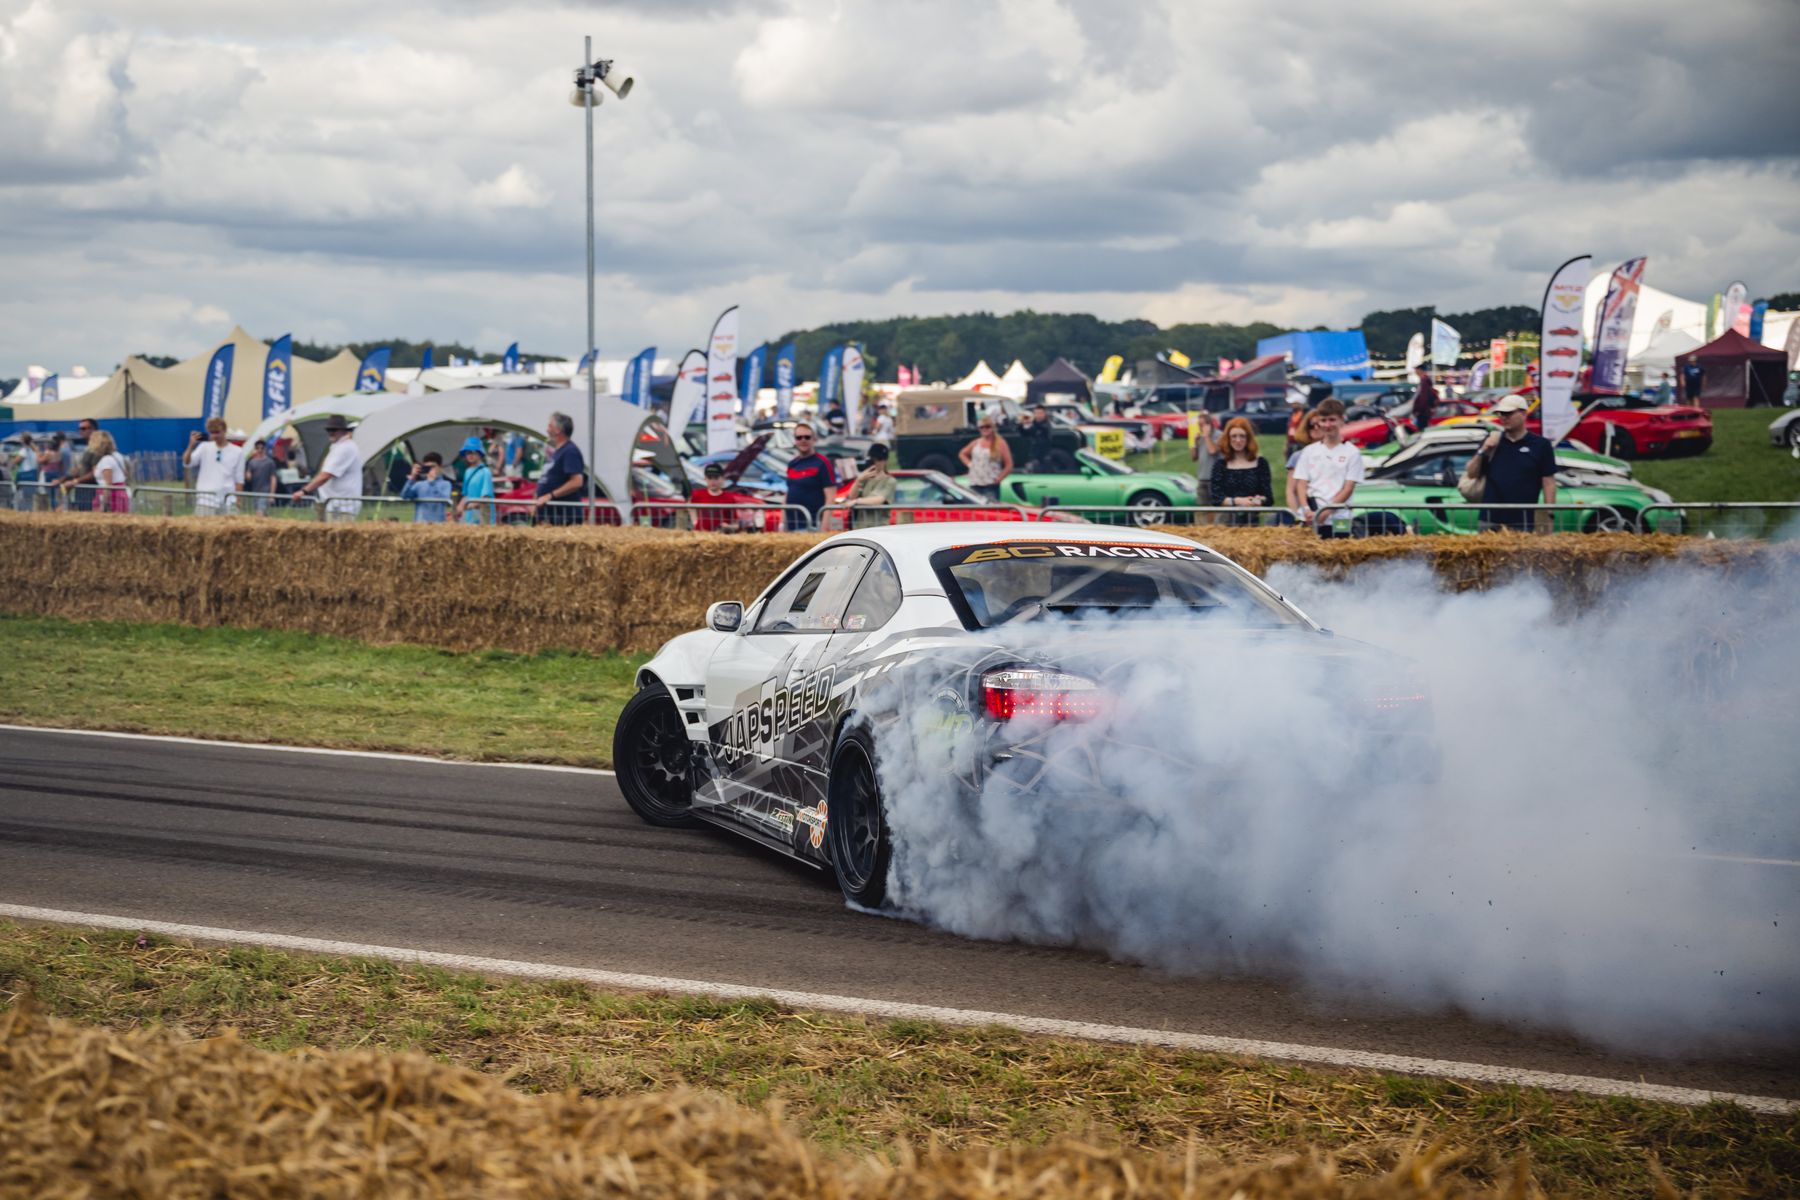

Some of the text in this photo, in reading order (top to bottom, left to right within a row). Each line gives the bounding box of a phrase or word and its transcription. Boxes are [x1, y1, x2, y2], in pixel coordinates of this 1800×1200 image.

[961, 545, 1201, 564] BC RACING
[724, 663, 837, 765] JAPSPEED
